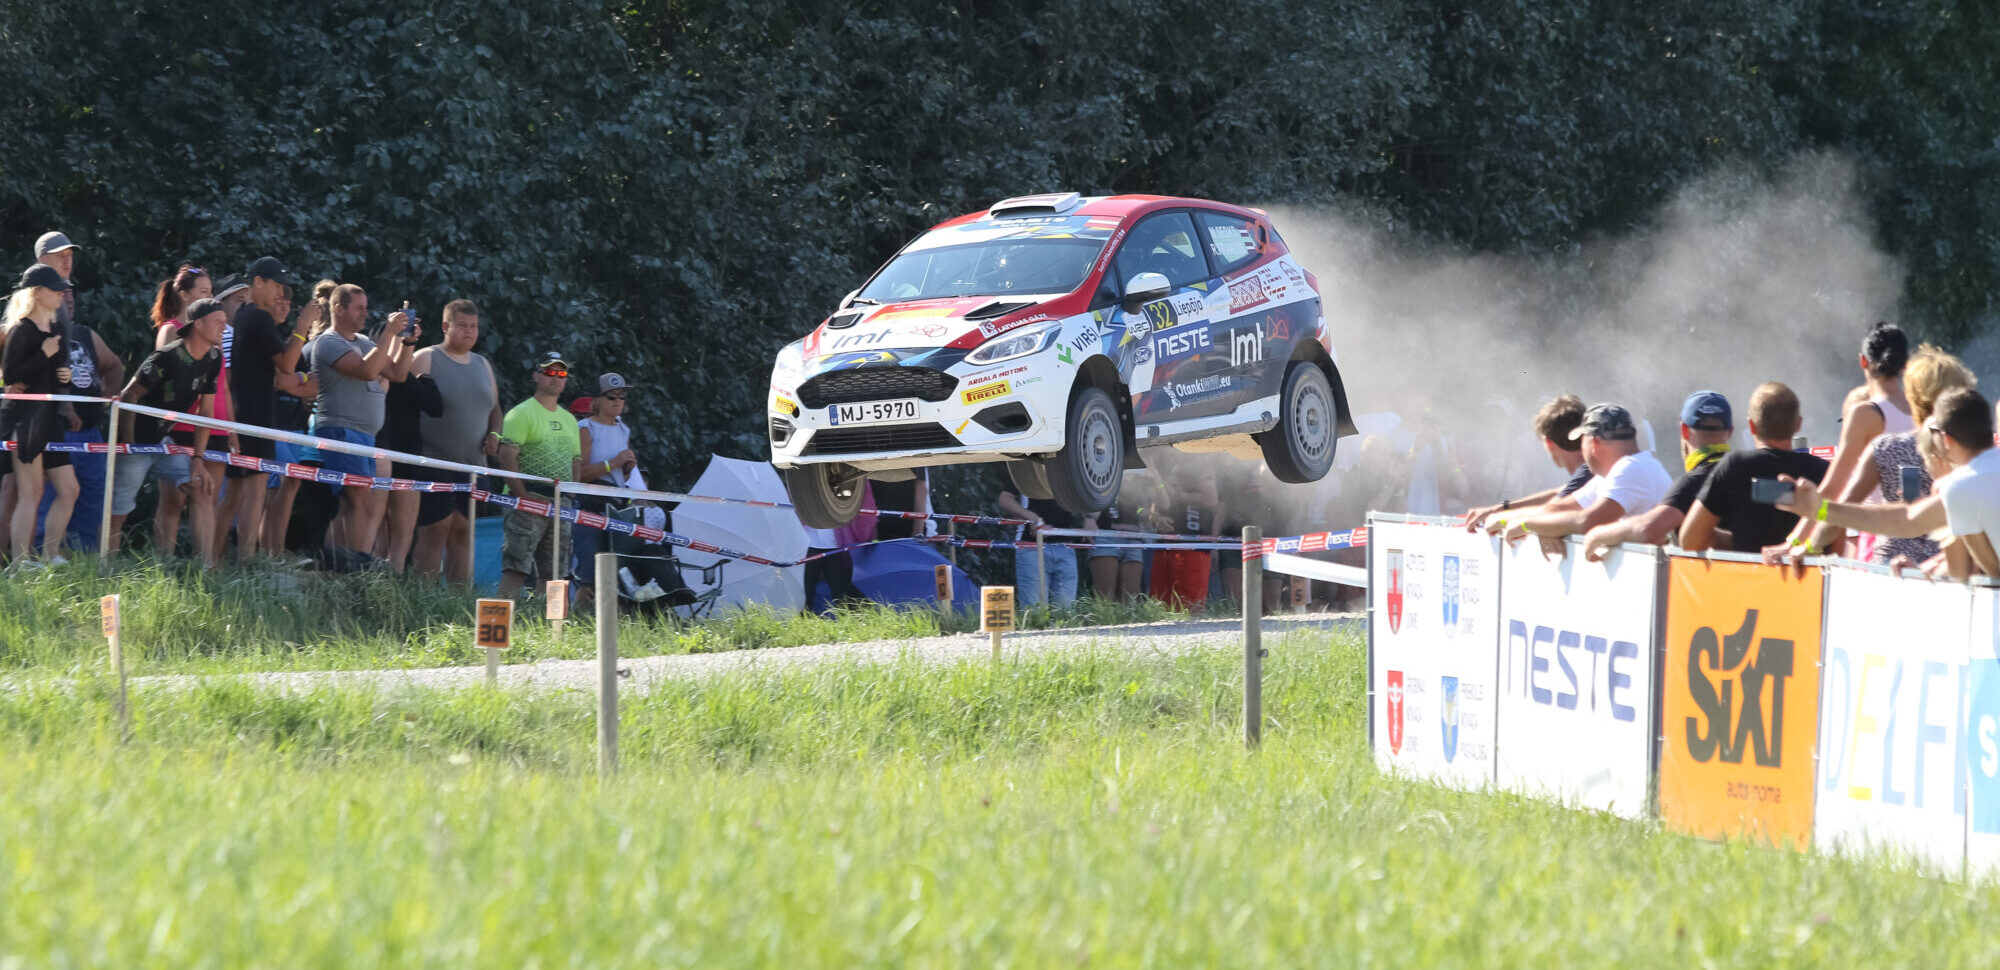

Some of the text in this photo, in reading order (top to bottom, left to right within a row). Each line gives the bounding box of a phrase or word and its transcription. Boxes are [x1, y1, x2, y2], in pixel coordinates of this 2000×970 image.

[1149, 302, 1173, 330] 32
[1127, 321, 1151, 335] WRC
[1157, 327, 1211, 359] NESTE
[998, 365, 1029, 378] MOTORS
[966, 383, 1008, 402] PIRELLI
[840, 401, 915, 423] MJ-5970
[986, 609, 1012, 628] 25
[480, 624, 507, 643] 30
[1507, 618, 1639, 723] NESTE
